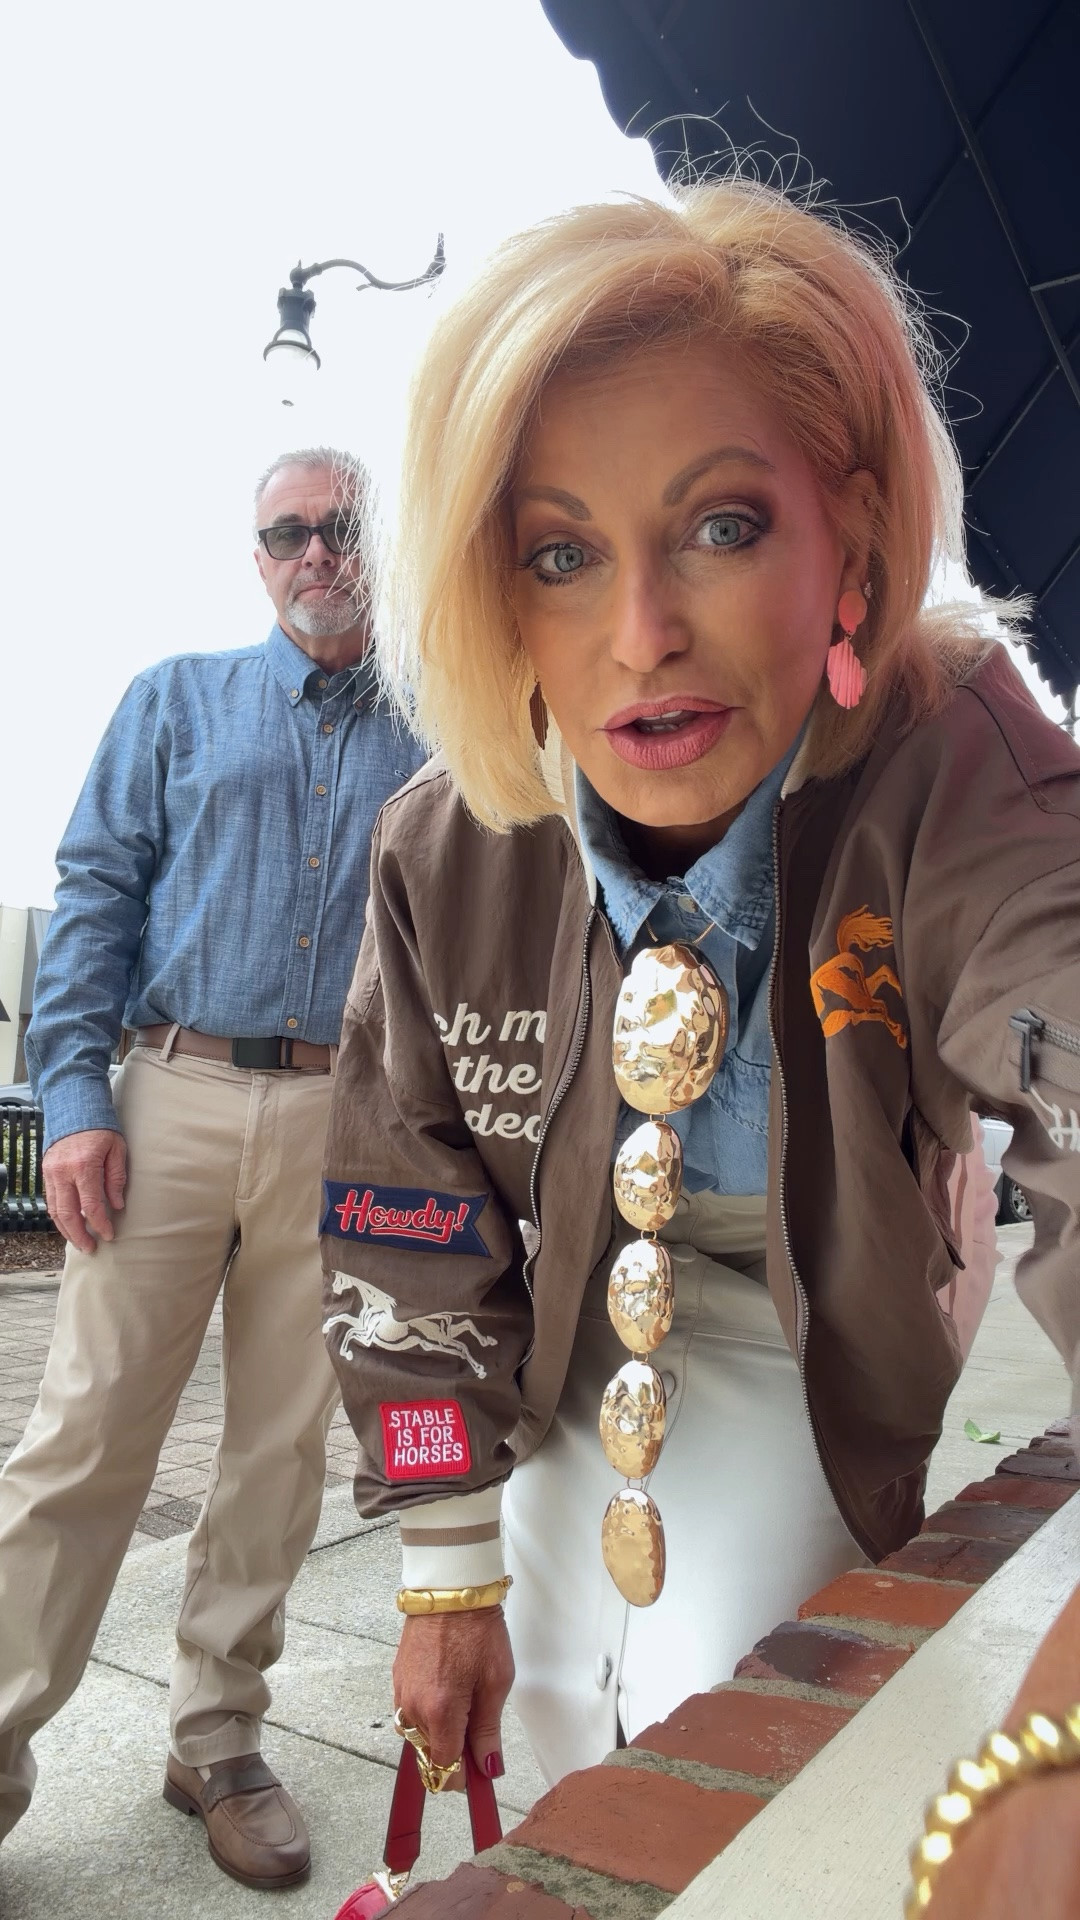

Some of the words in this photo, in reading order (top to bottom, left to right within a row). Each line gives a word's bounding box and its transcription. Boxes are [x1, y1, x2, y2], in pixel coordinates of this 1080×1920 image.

[453, 1054, 542, 1095] the
[335, 1189, 470, 1244] Howdy!
[389, 1408, 455, 1428] STABLE
[397, 1428, 413, 1447] IS
[420, 1425, 454, 1445] FOR
[394, 1442, 463, 1467] HORSES
